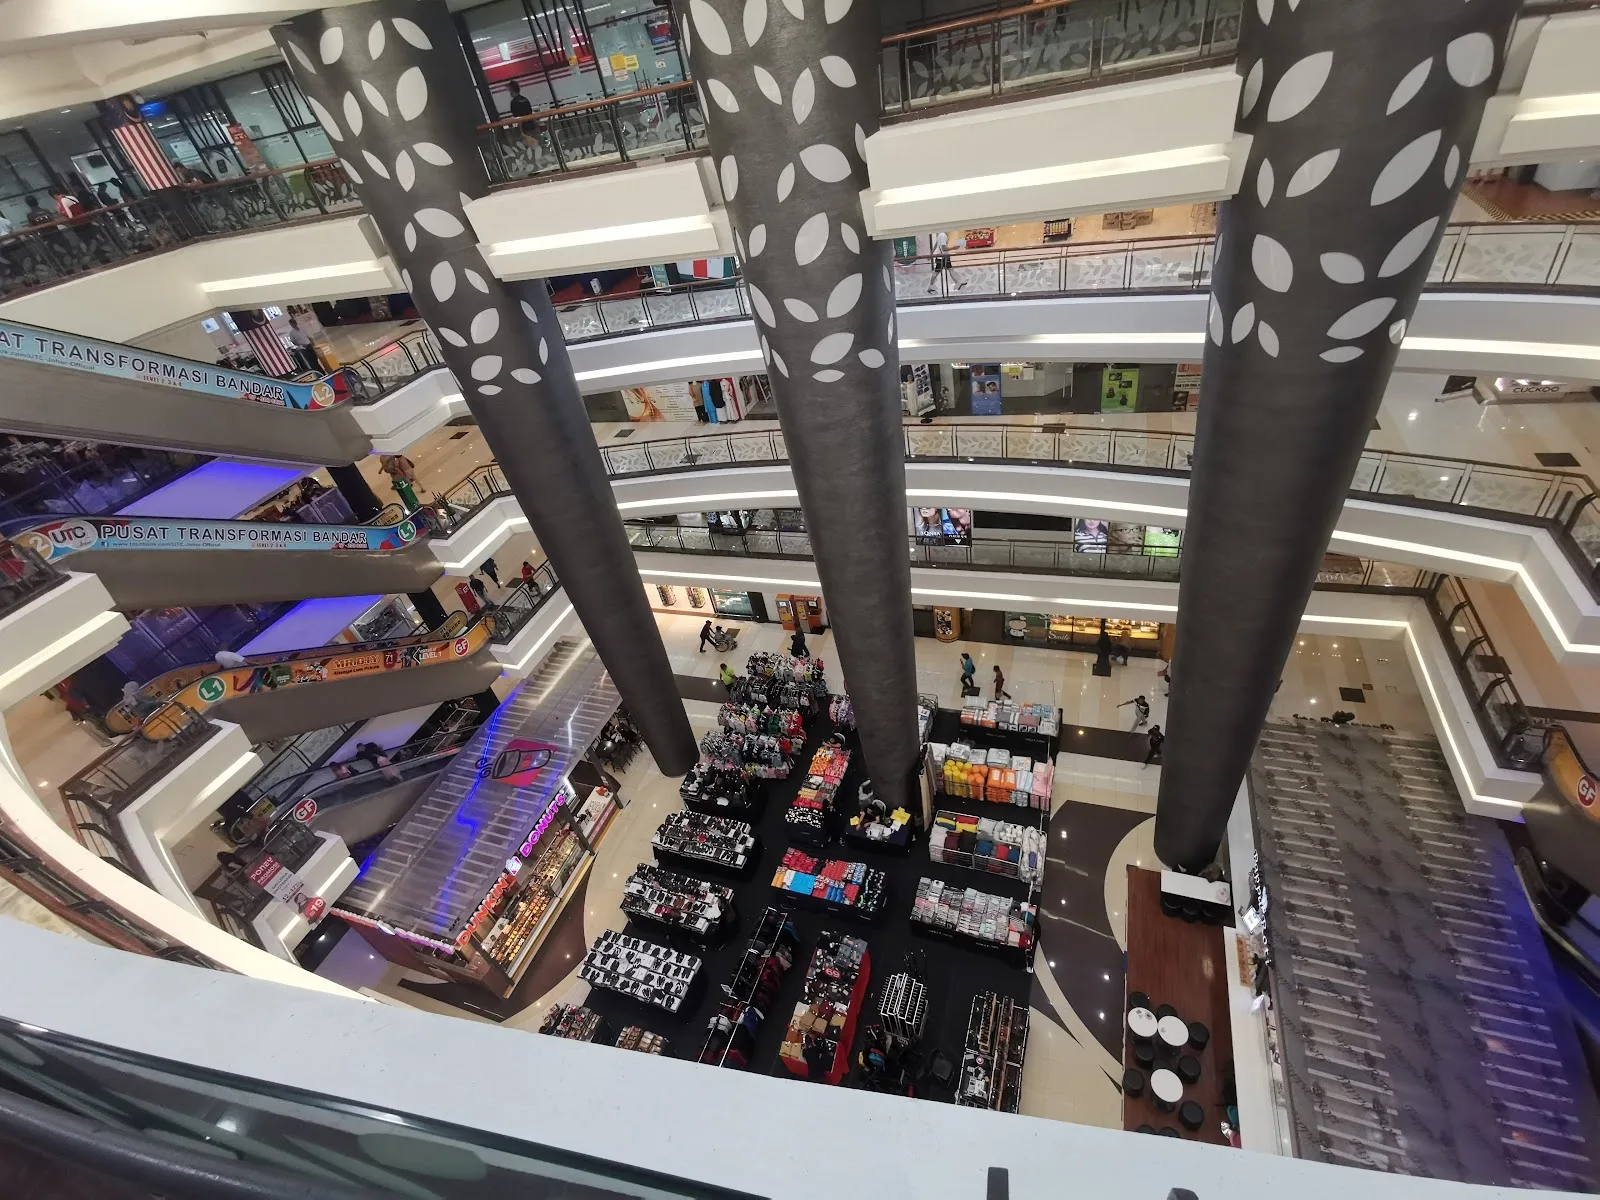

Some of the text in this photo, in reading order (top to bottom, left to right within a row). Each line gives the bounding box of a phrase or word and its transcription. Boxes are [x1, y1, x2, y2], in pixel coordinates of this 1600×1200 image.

[35, 338, 207, 384] TRANSFORMASI
[216, 374, 284, 399] BANDAR
[314, 386, 333, 401] L2
[51, 526, 86, 543] UTC
[102, 526, 366, 543] PUSAT TRANSFORMASI BANDAR
[400, 523, 414, 538] L1
[419, 651, 438, 660] LEVEL
[456, 641, 468, 653] GF
[201, 680, 223, 699] L1
[1579, 779, 1596, 801] GF
[296, 801, 313, 819] GF
[520, 793, 566, 857] DONUTS
[250, 856, 273, 880] PONEY
[457, 873, 508, 946] DUNKIN'
[825, 968, 840, 978] 69
